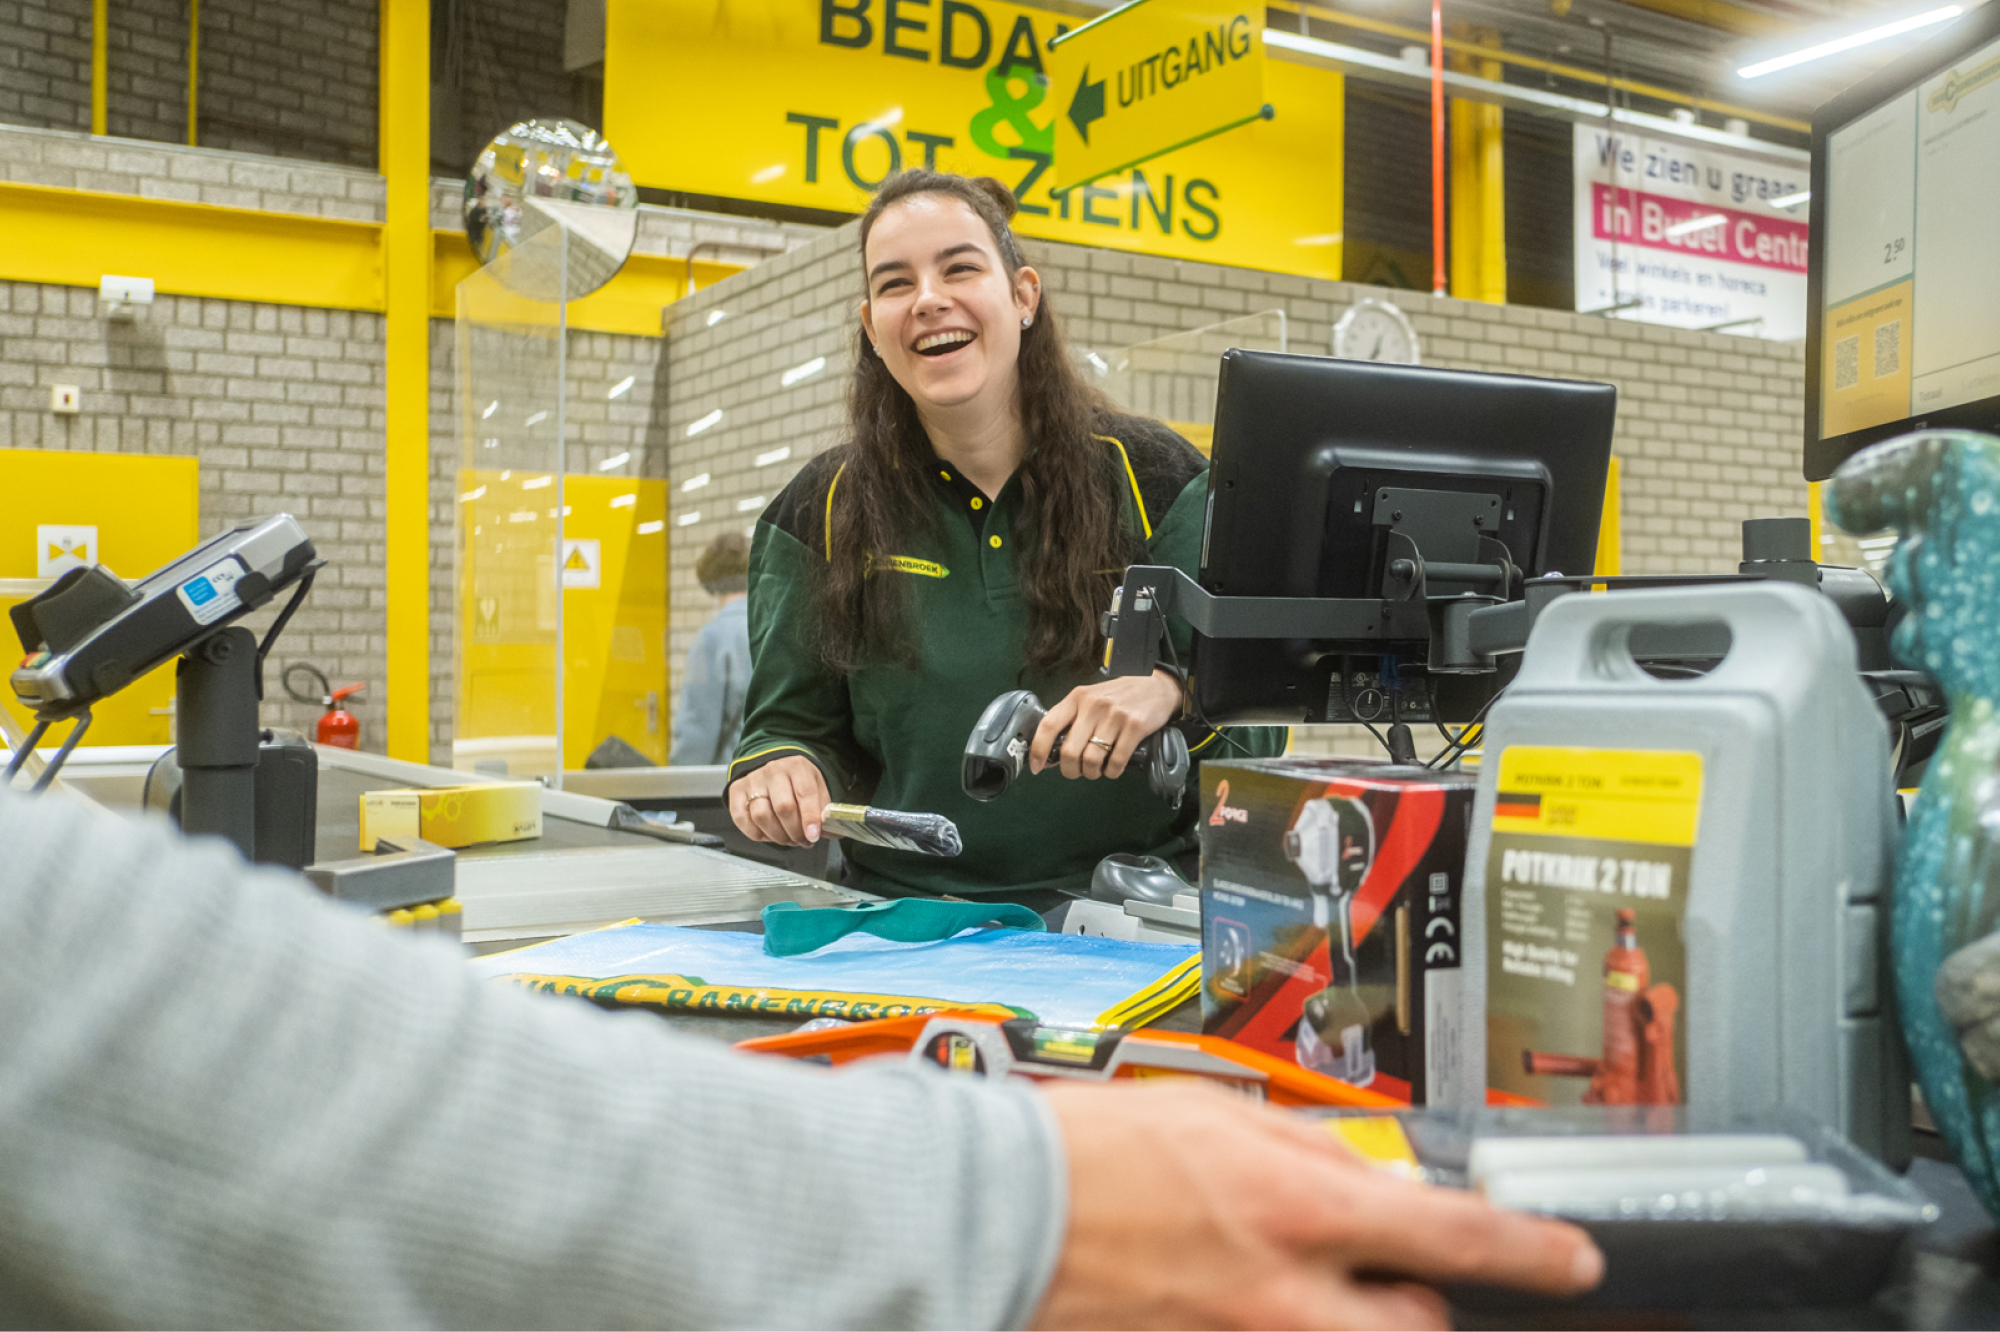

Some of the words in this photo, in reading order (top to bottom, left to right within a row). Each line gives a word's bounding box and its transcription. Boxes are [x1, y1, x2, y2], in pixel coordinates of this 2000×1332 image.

[819, 0, 1070, 85] BEDA
[1117, 14, 1250, 107] UITGANG
[786, 111, 955, 192] TOT
[1595, 136, 1634, 173] We
[1646, 146, 1699, 187] zien
[1706, 166, 1722, 191] u
[1602, 191, 1631, 237] in
[1641, 200, 1727, 254] Budel
[1599, 857, 1619, 894] 2
[1620, 859, 1673, 901] TON
